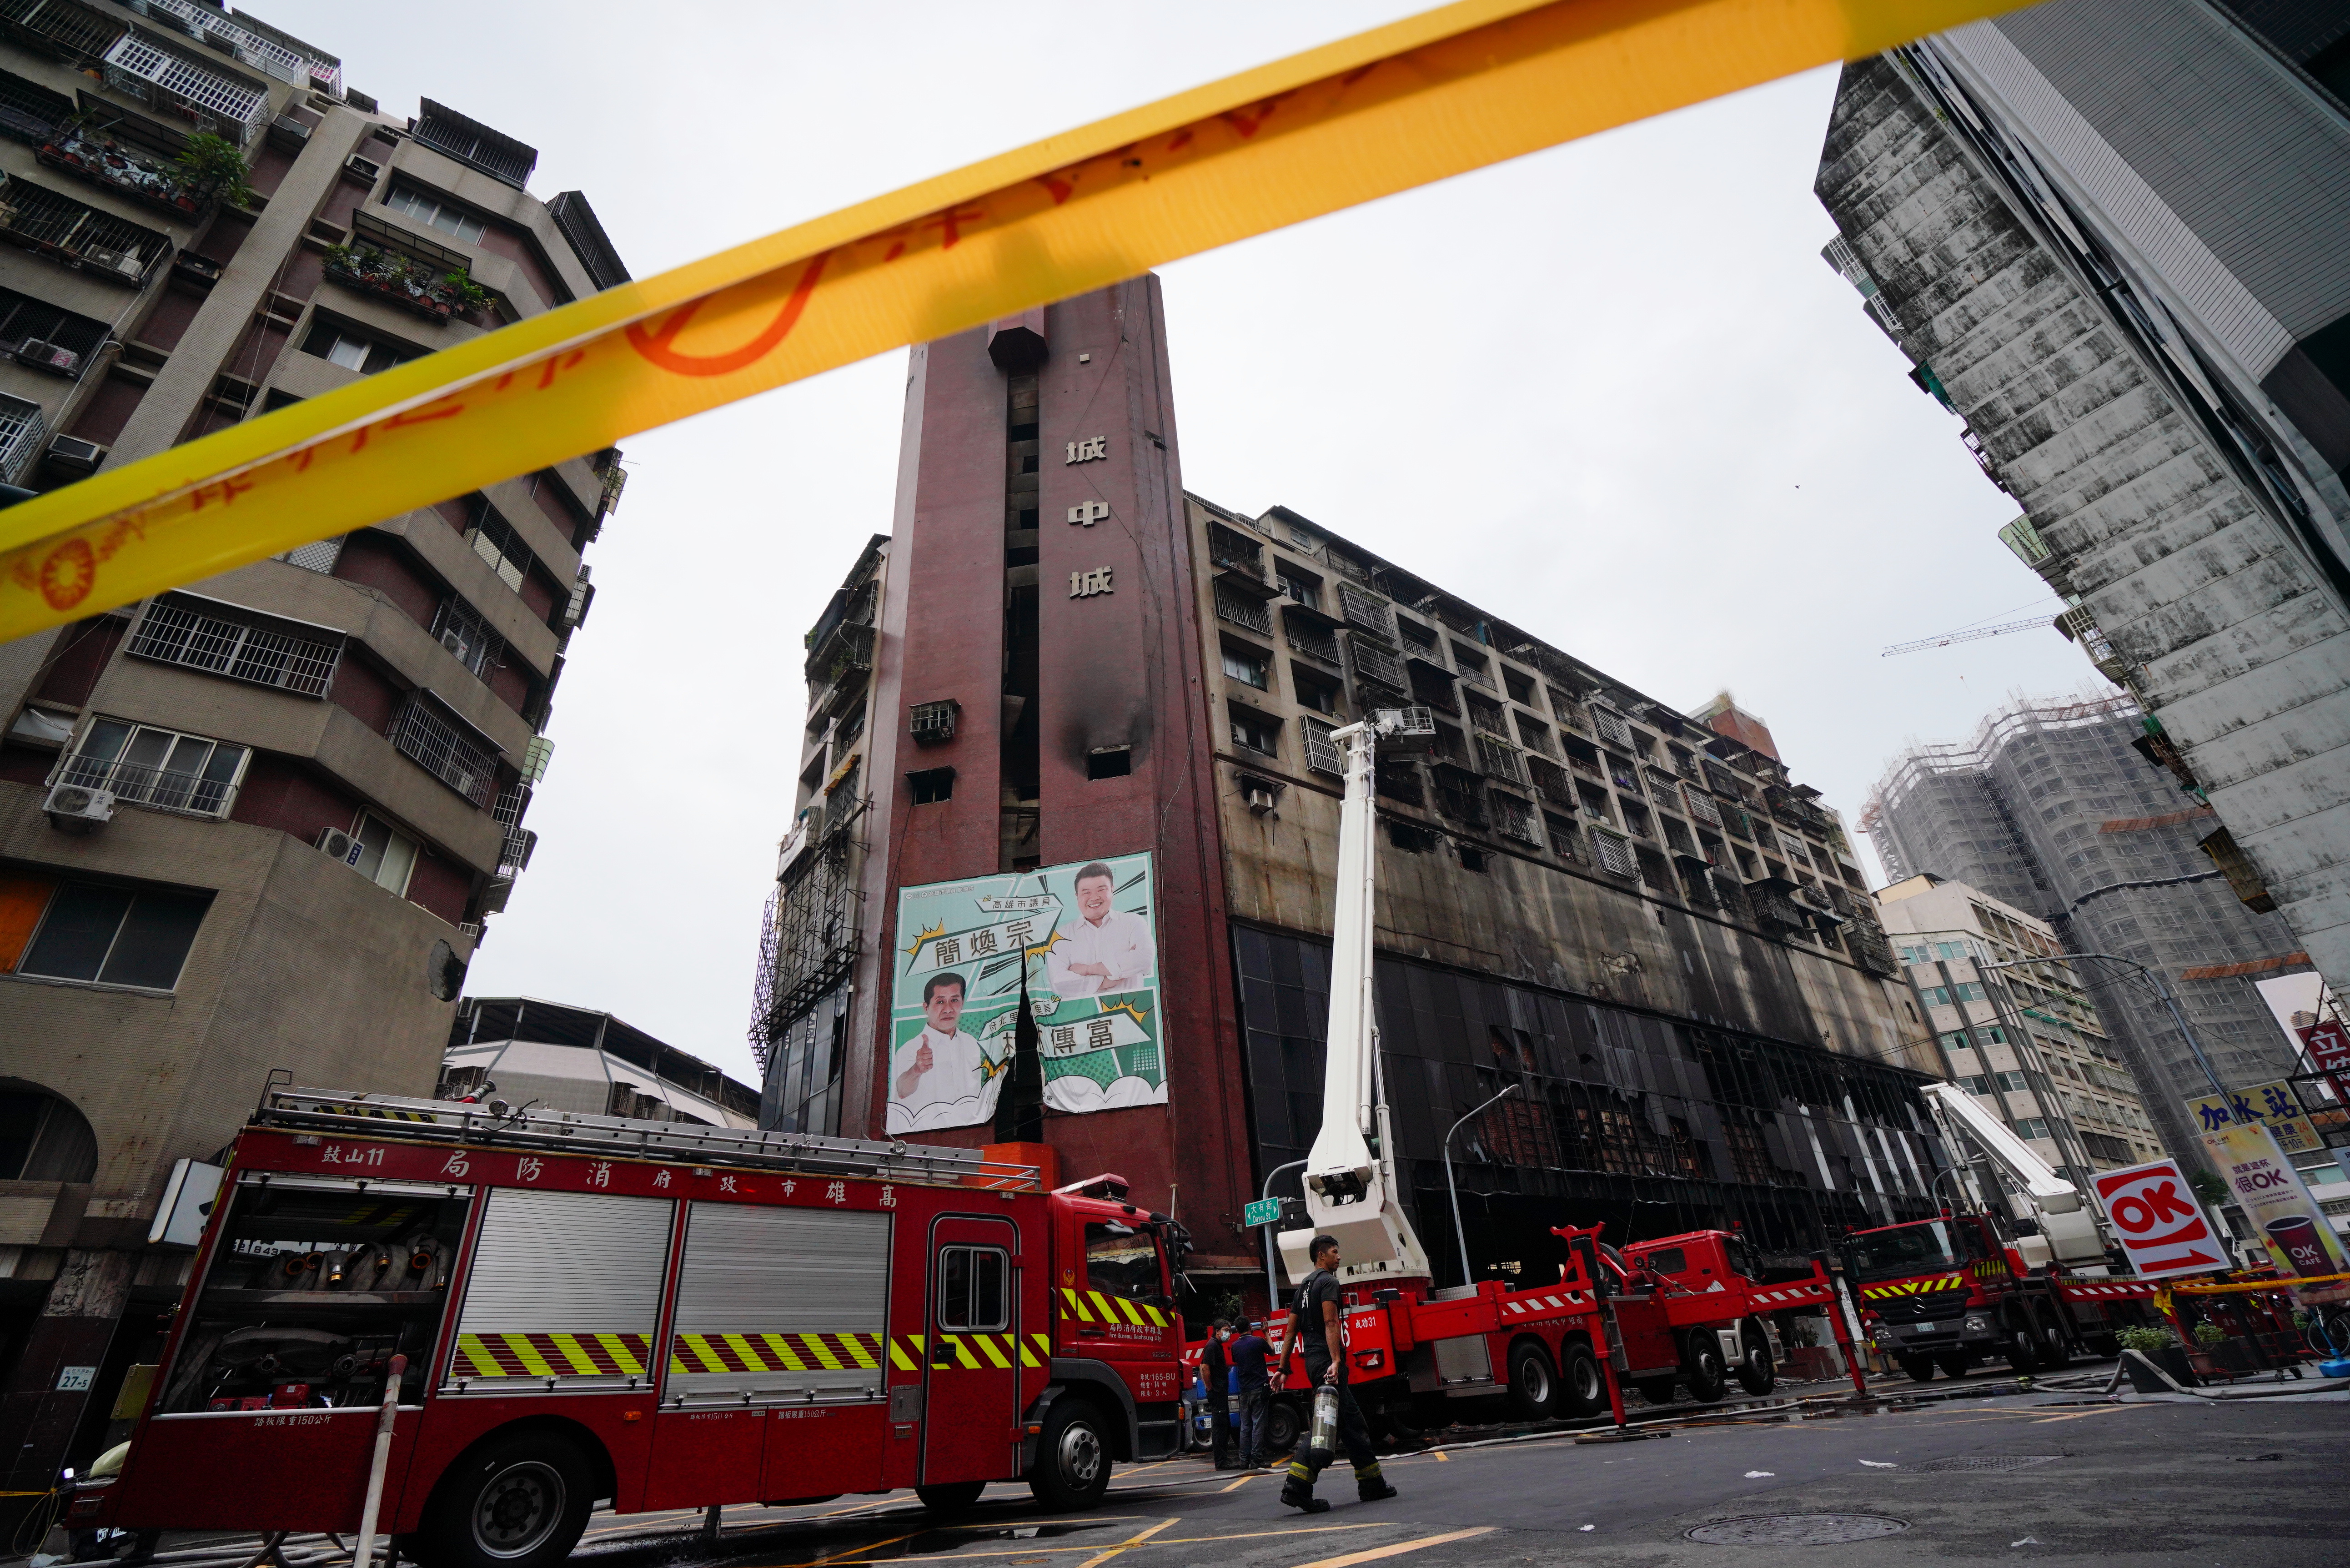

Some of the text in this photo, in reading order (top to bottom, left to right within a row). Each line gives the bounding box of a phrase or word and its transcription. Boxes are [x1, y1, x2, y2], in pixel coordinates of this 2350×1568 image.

[1065, 435, 1114, 599] 城中城
[993, 896, 1051, 910] 高雄市議員
[934, 921, 1034, 967] 簡煥宗
[2199, 1086, 2299, 1131] 加水站
[2295, 1121, 2309, 1133] 24
[2232, 1159, 2271, 1174] 就是這杯
[1250, 1201, 1272, 1214] 大有街
[2111, 1181, 2195, 1233] OK
[1253, 1215, 1265, 1223] Dayou
[2291, 1244, 2318, 1258] OK
[2299, 1256, 2321, 1266] CAFÉ
[1355, 1317, 1376, 1329] 成功31
[61, 1376, 88, 1387] 27-5
[254, 1414, 332, 1427] 踏板限重150公斤
[778, 1409, 826, 1419] 踏板限重150公斤
